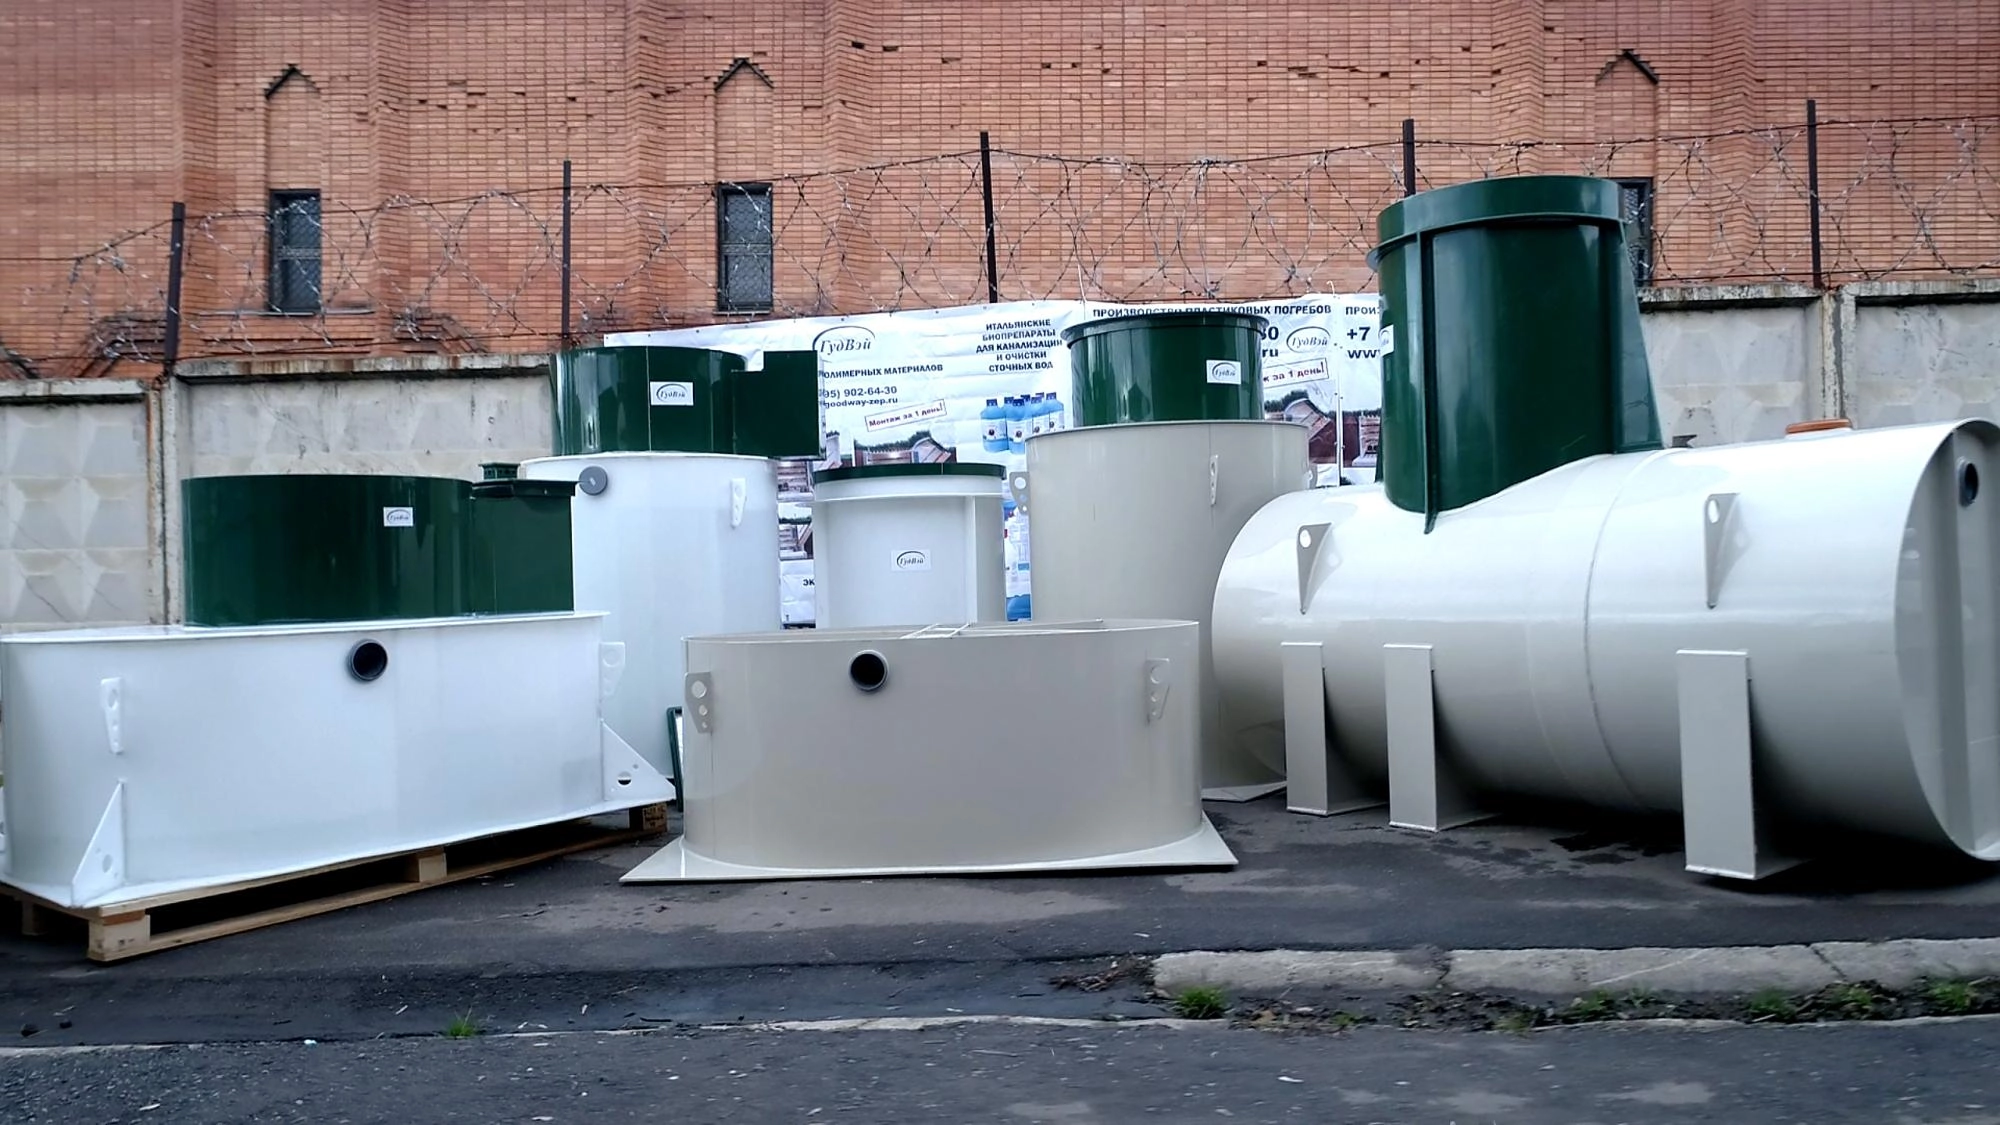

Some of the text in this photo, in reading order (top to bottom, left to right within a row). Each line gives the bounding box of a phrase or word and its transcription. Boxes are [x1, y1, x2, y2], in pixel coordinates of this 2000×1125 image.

[1274, 304, 1332, 315] ПОГРЕБОВ
[986, 319, 1051, 331] ИТАЛЬЯНСКИЕ
[982, 329, 1056, 341] БИОПРЕПАРАТЫ
[1346, 326, 1371, 341] +7
[976, 339, 1063, 354] ДЛЯ КАНАЛИЗАЦИИ
[1005, 351, 1047, 361] ОЧИСТКИ
[1347, 349, 1380, 359] ww
[884, 364, 943, 375] МАТЕРИАЛОВ
[989, 361, 1053, 373] СТОЧНЫХ ВОД
[1297, 361, 1324, 377] день!
[844, 386, 898, 397] 902-64-30
[869, 415, 901, 427] Монтаж
